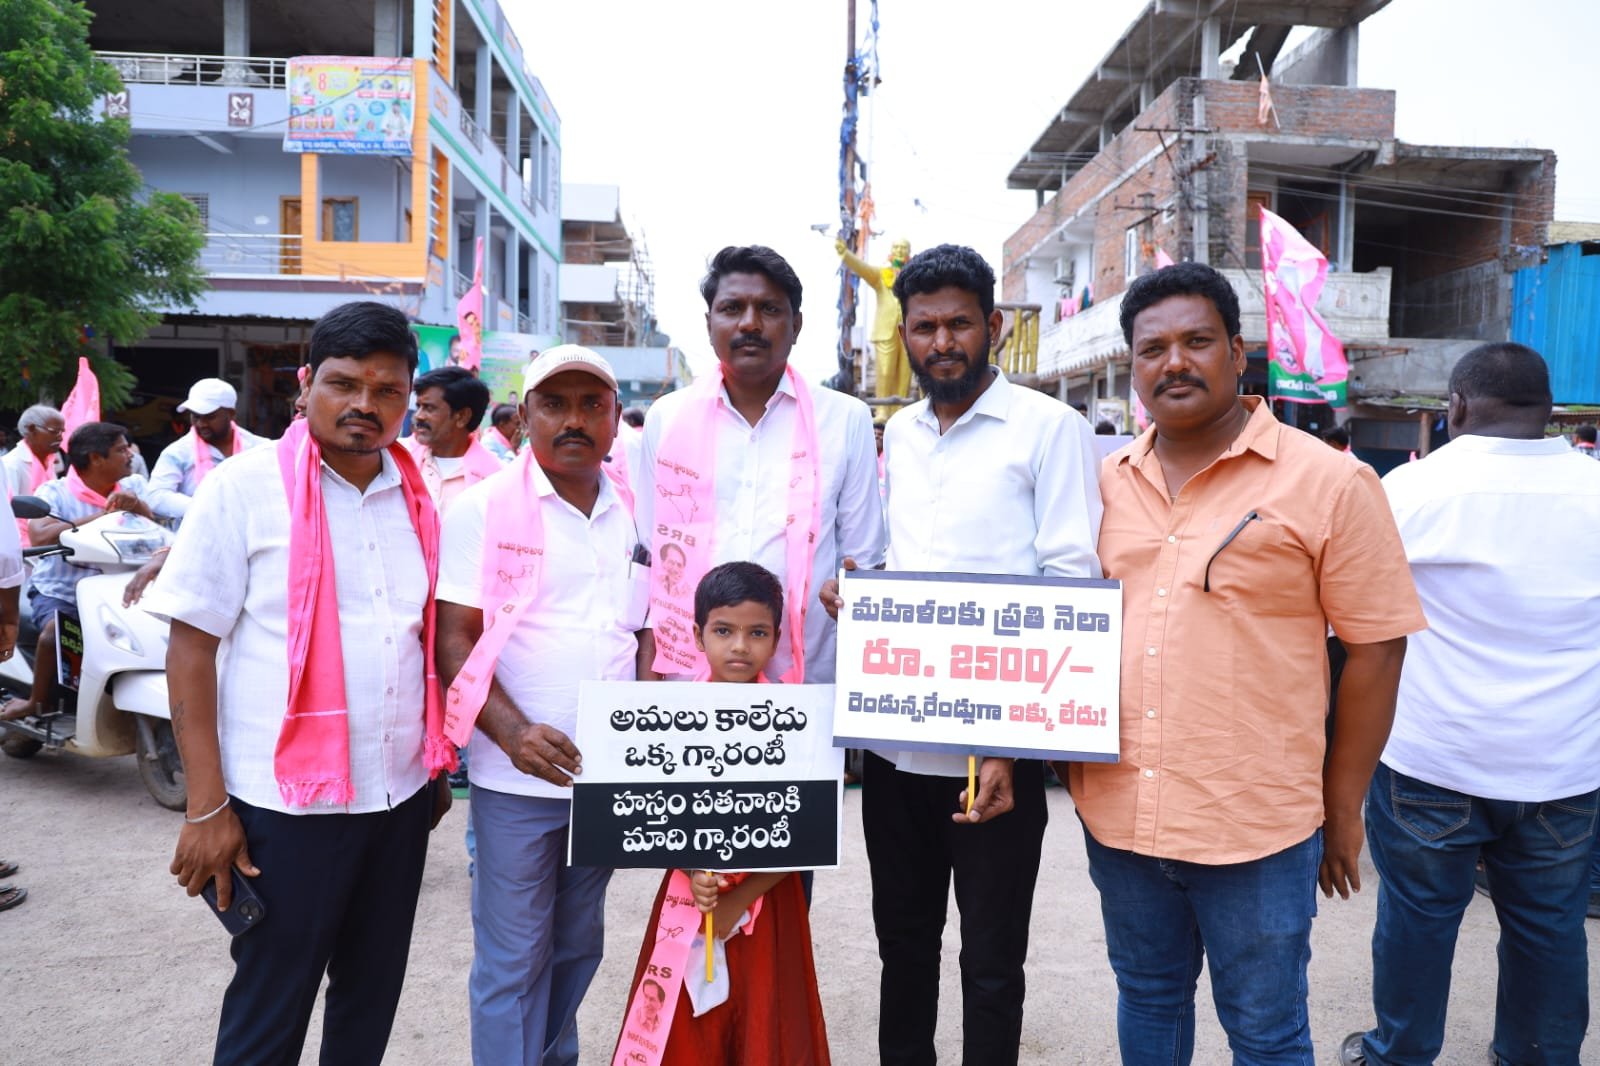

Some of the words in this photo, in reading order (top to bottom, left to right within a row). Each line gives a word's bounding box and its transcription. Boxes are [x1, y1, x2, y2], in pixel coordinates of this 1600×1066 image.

[852, 596, 985, 627] మహిళలకు
[994, 603, 1045, 636] ప్రతి
[1054, 604, 1110, 633] నెలా
[862, 638, 935, 677] రూ.
[950, 644, 1094, 694] 2500/-
[610, 705, 708, 732] అమలు
[715, 699, 808, 732] కాలేదు
[1008, 702, 1055, 732] దిక్కు
[1059, 700, 1107, 727] లేదు!
[625, 742, 678, 775] ఒక్క
[683, 734, 786, 777] గ్యారంటీ
[612, 790, 687, 825] హస్తం
[692, 785, 801, 815] పతనానికి
[622, 826, 688, 852] మాది
[693, 815, 791, 861] గ్యారంటీ
[647, 964, 673, 979] RS
